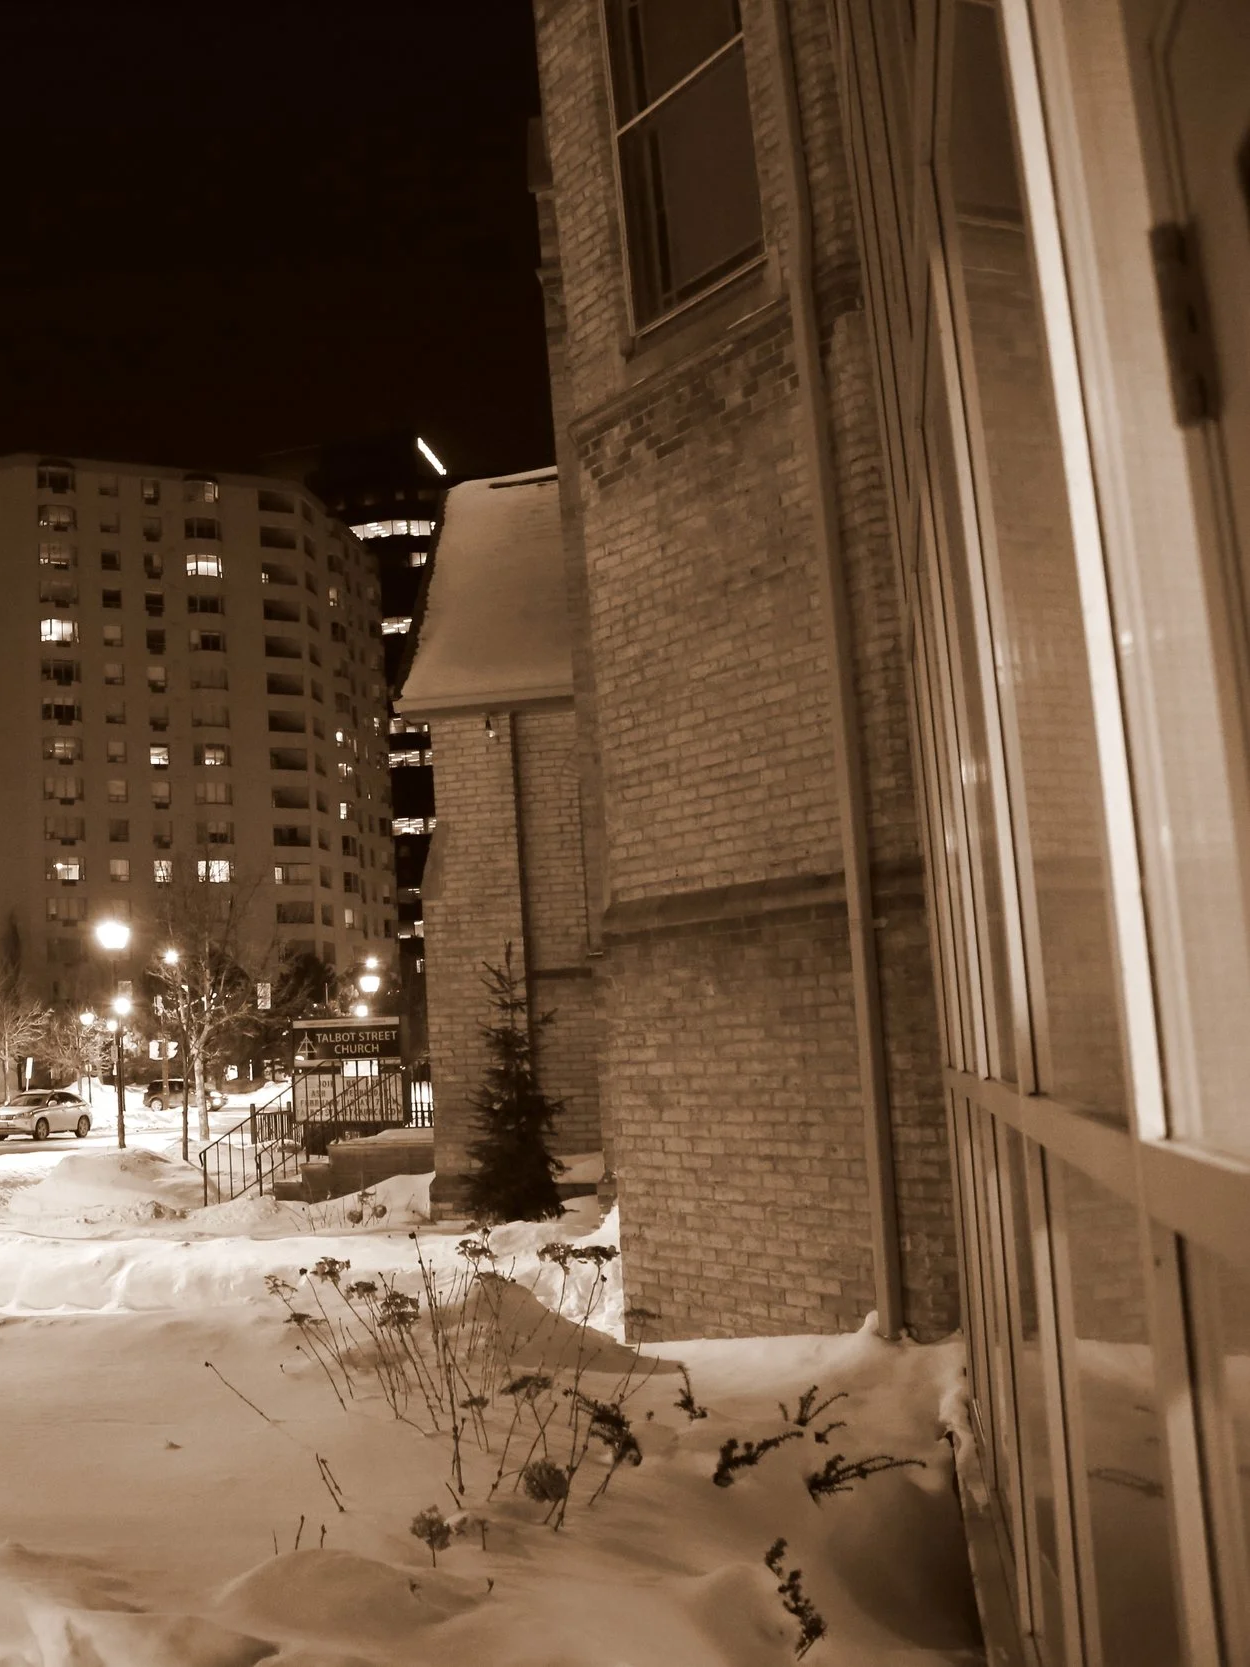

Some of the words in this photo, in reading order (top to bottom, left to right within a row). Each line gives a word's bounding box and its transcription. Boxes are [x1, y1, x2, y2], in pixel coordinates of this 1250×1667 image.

[316, 1032, 355, 1043] TALBOT
[358, 1030, 397, 1042] STREET
[334, 1043, 380, 1055] CHURCH
